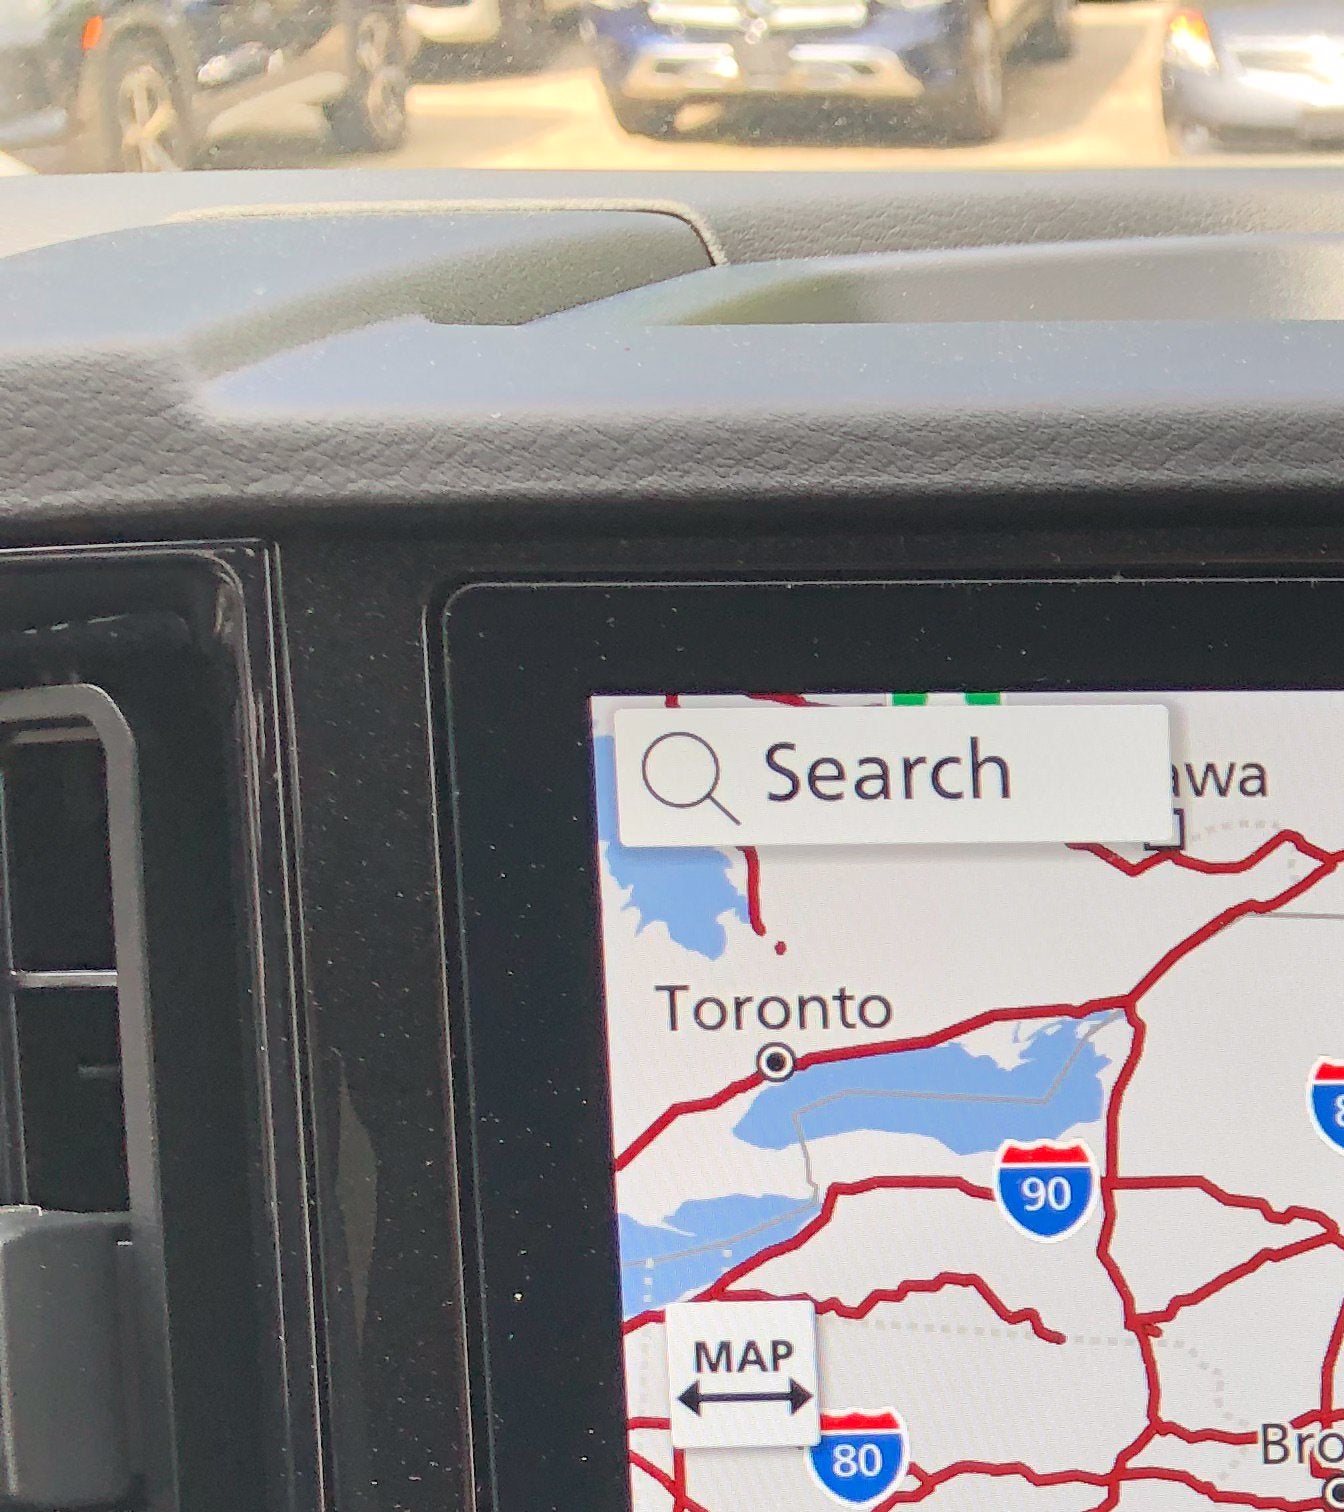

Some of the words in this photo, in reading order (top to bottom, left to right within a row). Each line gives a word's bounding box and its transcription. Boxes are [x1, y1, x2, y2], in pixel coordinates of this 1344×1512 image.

[766, 736, 1011, 801] Search
[1171, 762, 1268, 797] wa
[654, 985, 892, 1031] Toronto
[1021, 1176, 1073, 1212] 90
[694, 1339, 794, 1373] MAP
[832, 1443, 882, 1478] 80
